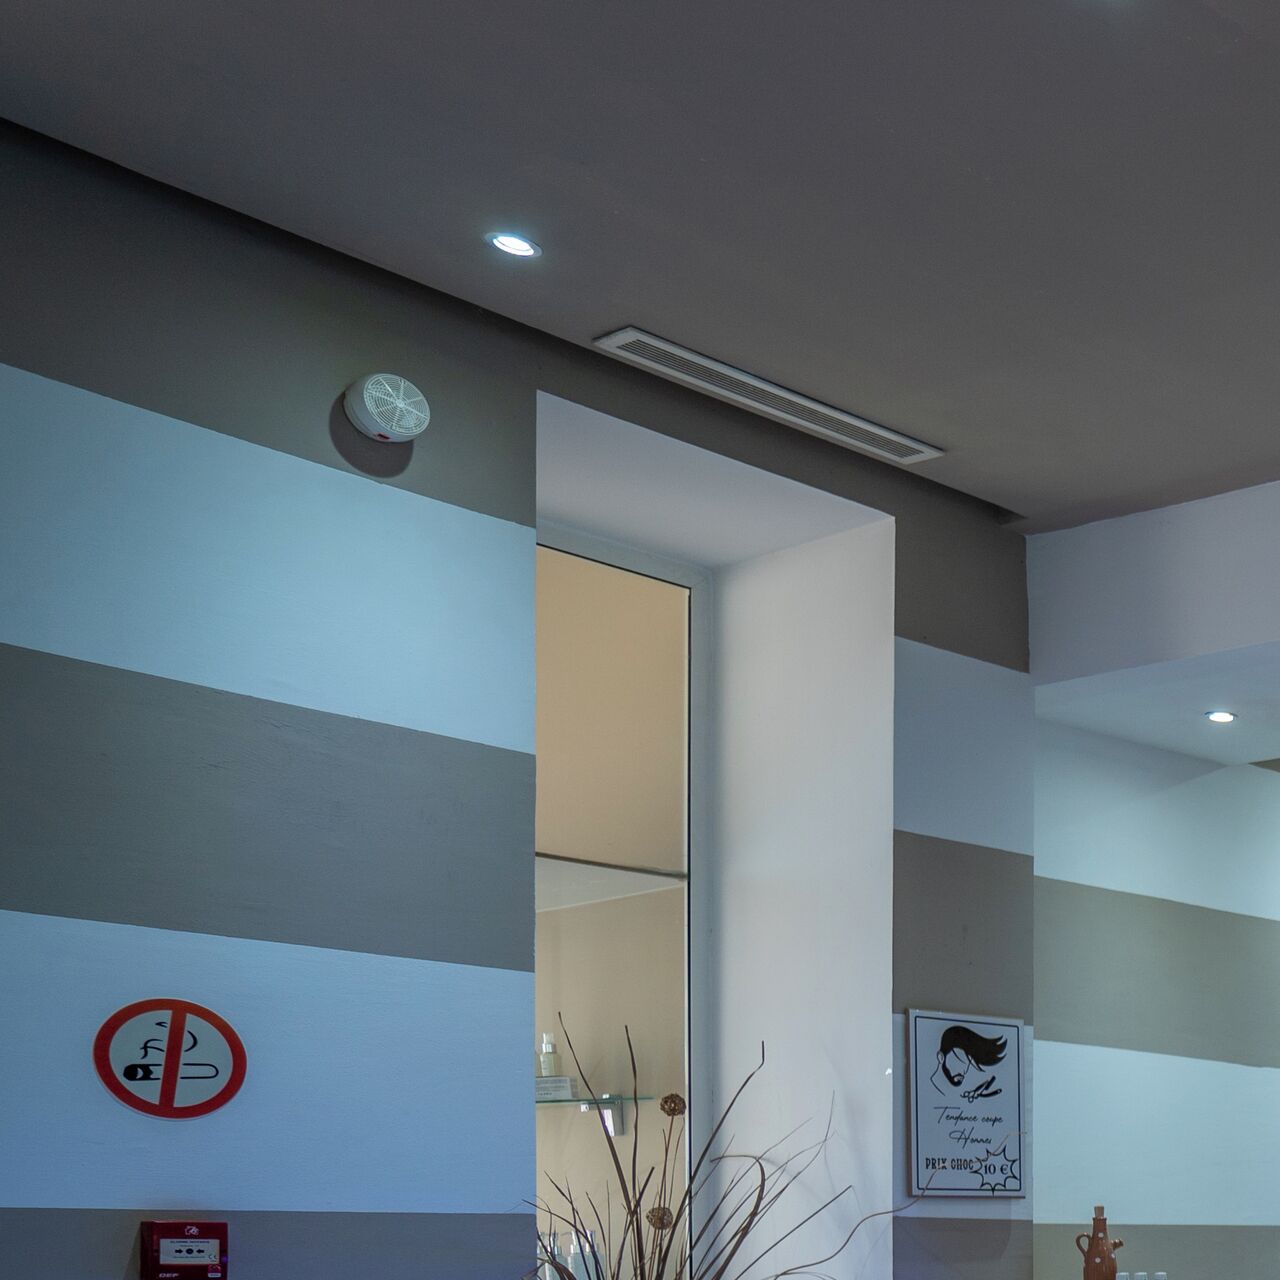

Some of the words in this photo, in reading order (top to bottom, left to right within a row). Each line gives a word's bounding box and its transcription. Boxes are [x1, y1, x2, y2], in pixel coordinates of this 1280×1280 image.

[933, 1106, 978, 1127] Tendance
[980, 1115, 1004, 1127] coupe
[925, 1157, 947, 1170] PRIX
[950, 1157, 974, 1170] CHOC
[984, 1163, 996, 1175] 10
[1000, 1163, 1009, 1175] €
